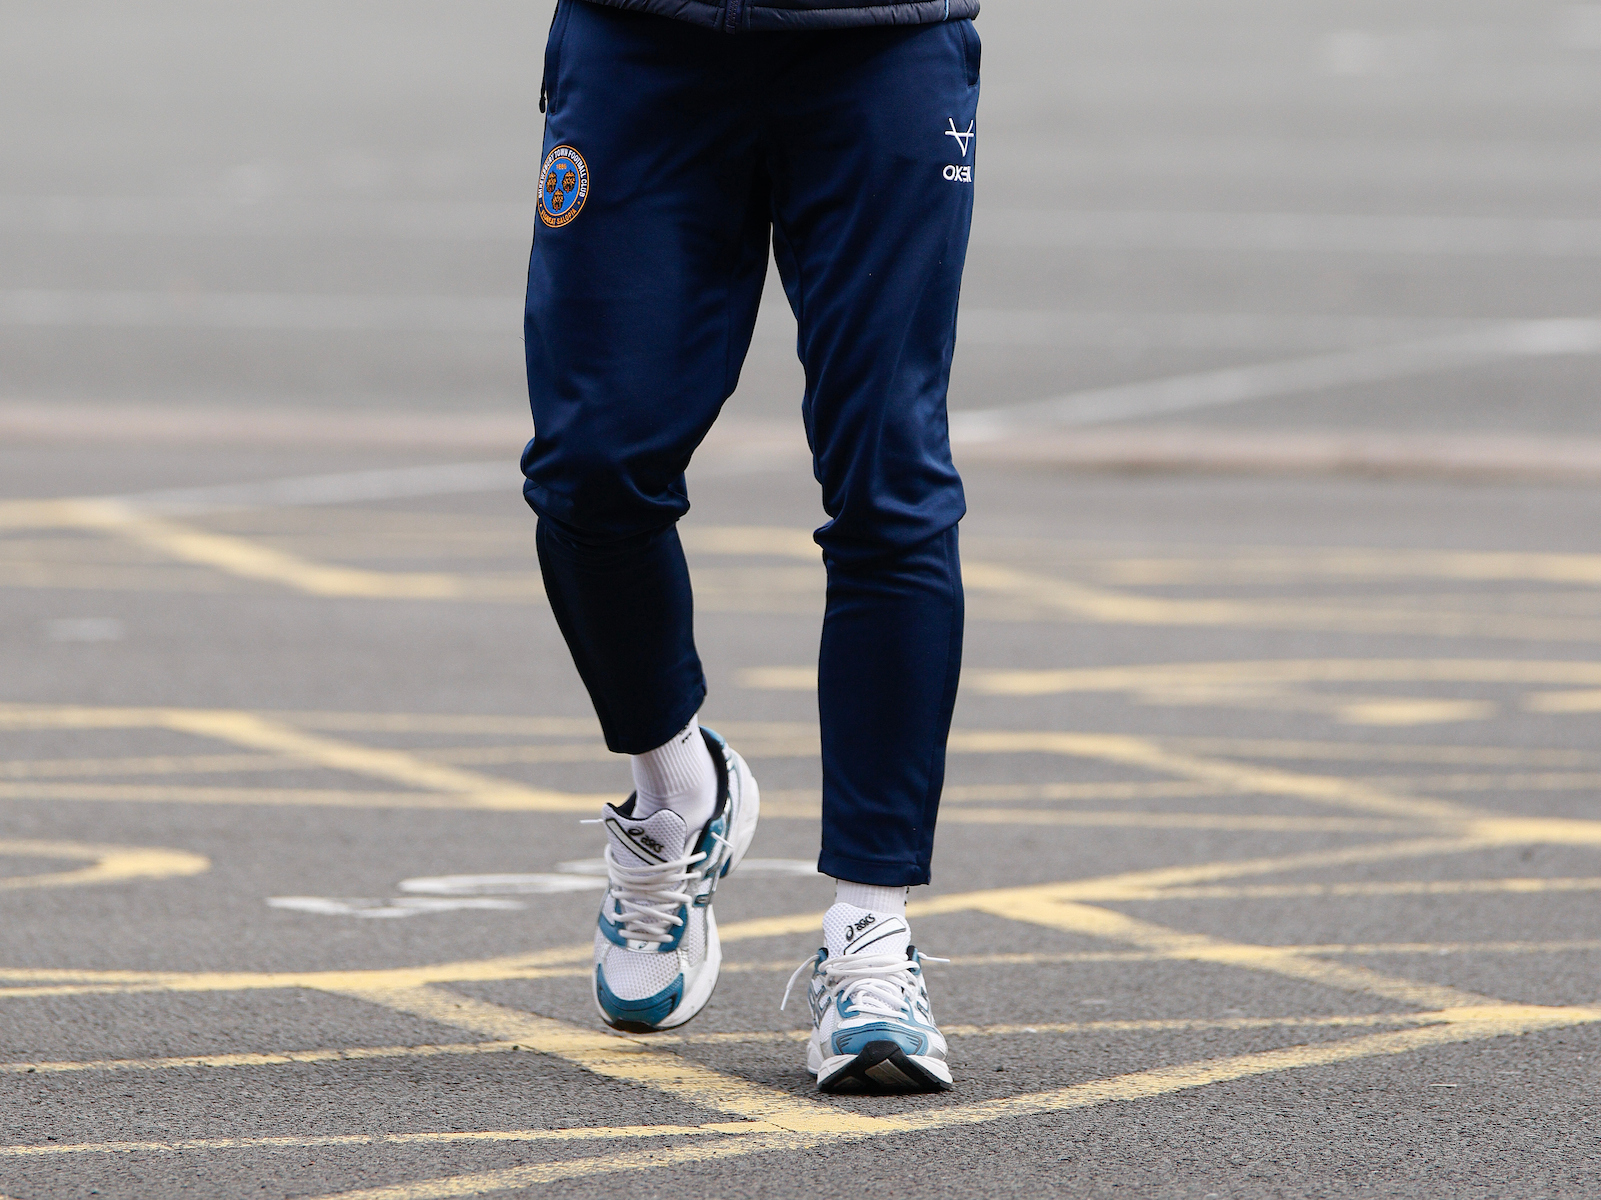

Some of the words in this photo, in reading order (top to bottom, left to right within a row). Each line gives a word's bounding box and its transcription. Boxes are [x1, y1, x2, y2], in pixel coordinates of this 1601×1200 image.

[568, 150, 586, 178] FOOTBALL
[579, 179, 587, 198] CLUB
[854, 913, 876, 931] asics
